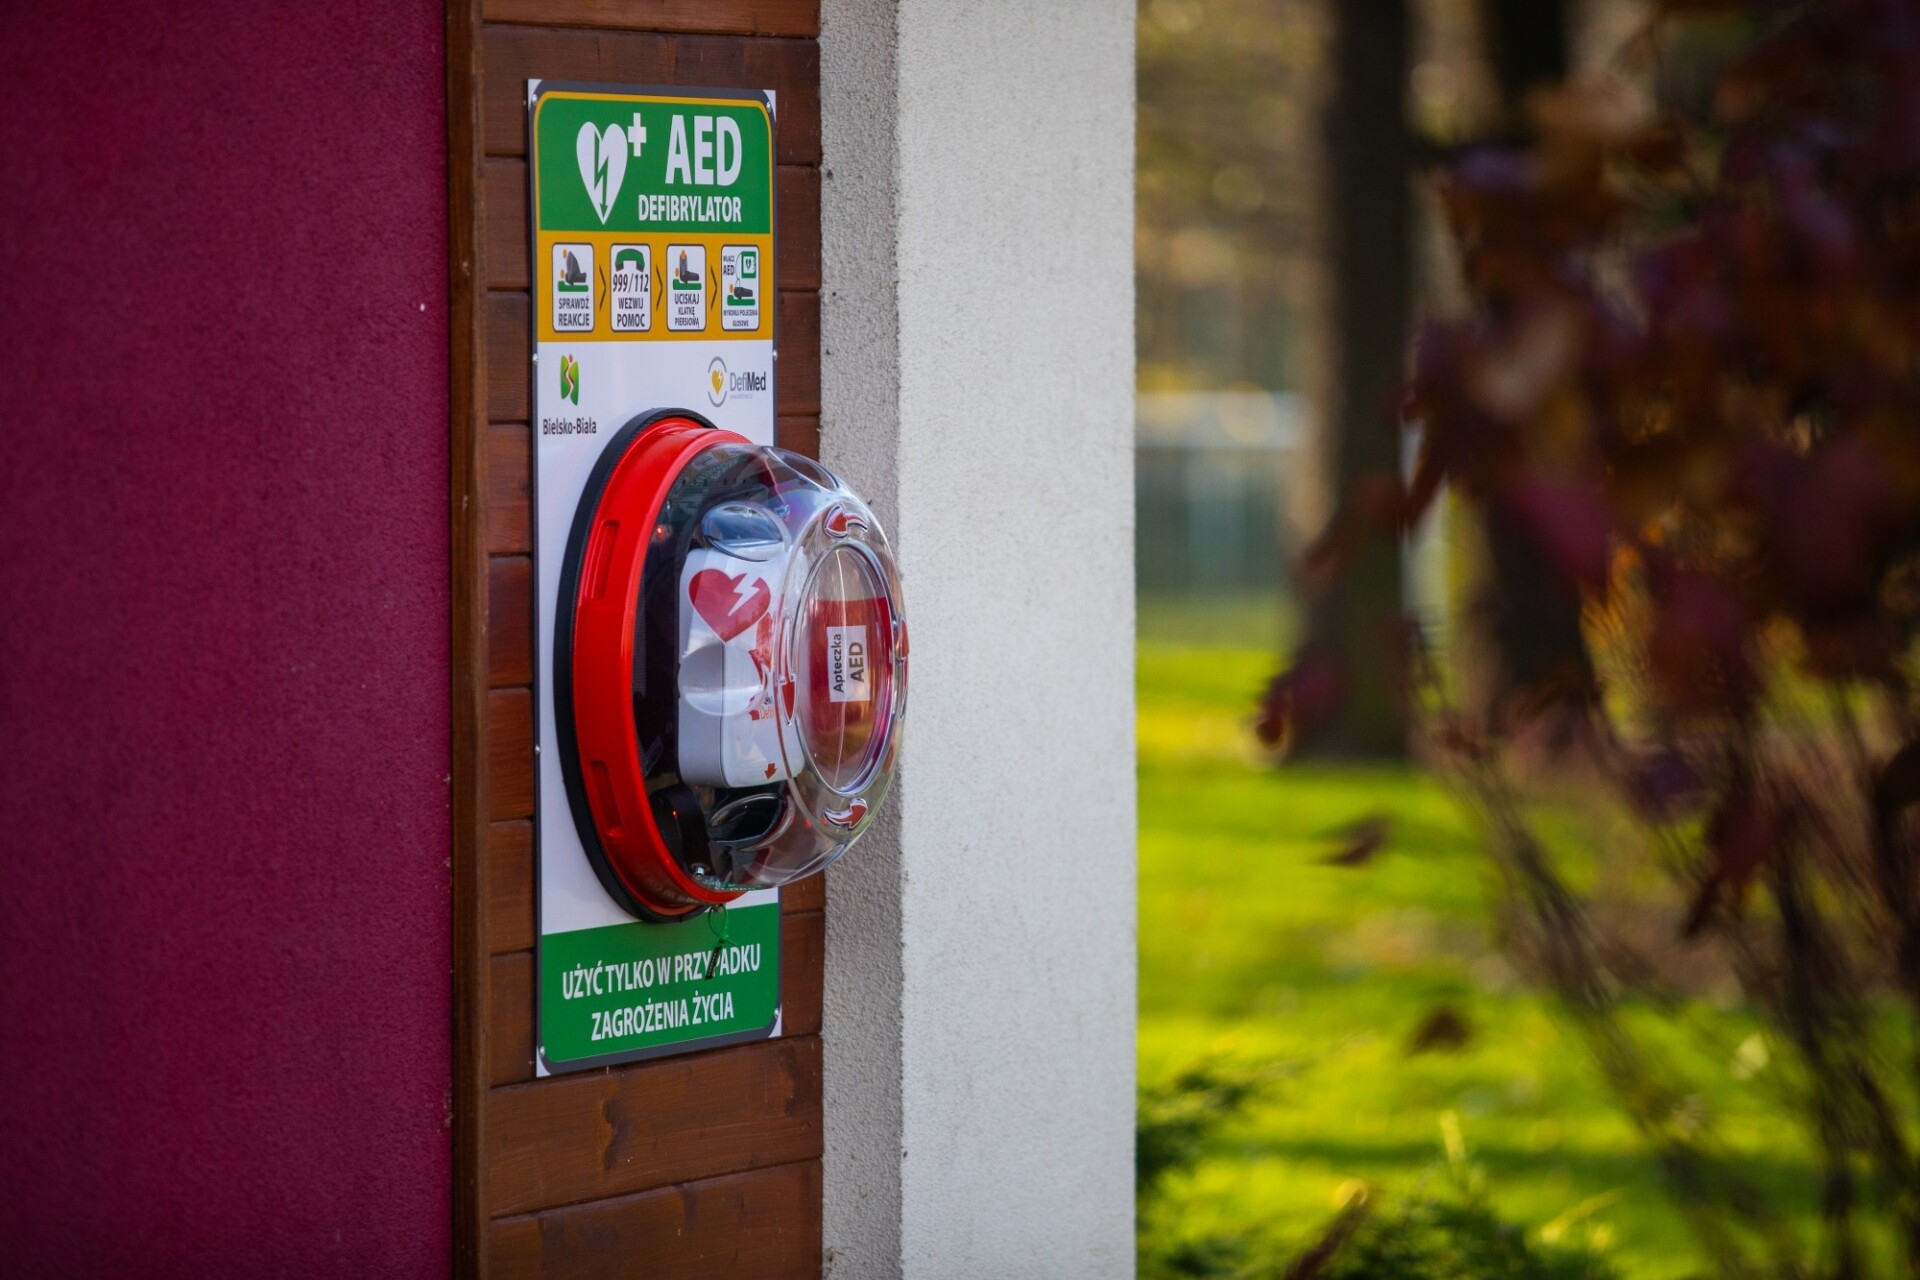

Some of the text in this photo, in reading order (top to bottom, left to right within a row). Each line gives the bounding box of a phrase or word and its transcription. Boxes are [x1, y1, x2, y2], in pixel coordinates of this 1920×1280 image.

[665, 114, 742, 186] AED
[638, 194, 742, 222] DEFIBRYLATOR
[612, 273, 649, 293] 999/112
[723, 264, 735, 275] AED
[674, 293, 700, 305] UCISKAJ
[616, 313, 645, 327] POMOC
[729, 371, 767, 392] DefiMed
[830, 633, 845, 694] Apteczka
[848, 641, 864, 683] AED
[562, 960, 604, 1000] UŻYĆ
[605, 958, 655, 993] TYLKO
[656, 956, 671, 985] W
[591, 989, 735, 1041] ZAGROŻENIA ŻYCIA
